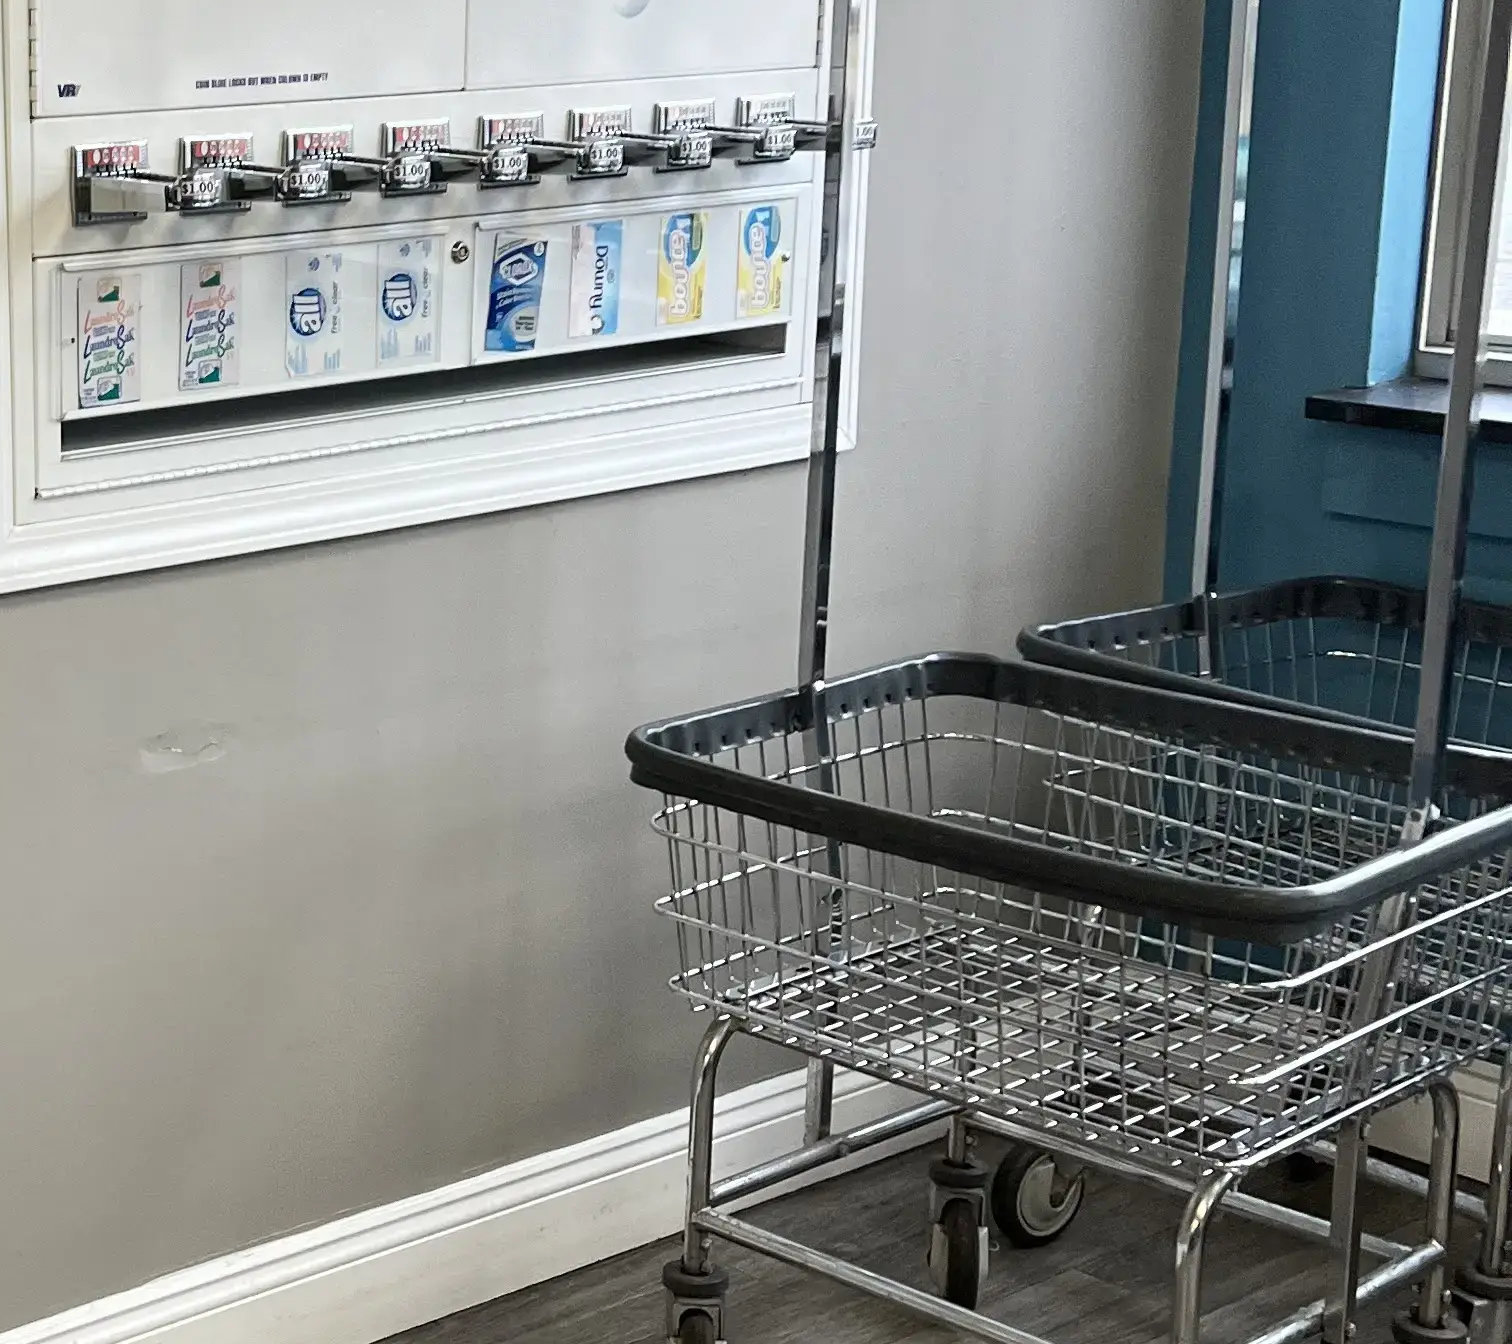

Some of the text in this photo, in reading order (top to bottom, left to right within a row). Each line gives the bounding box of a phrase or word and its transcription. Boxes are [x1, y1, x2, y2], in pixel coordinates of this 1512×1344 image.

[591, 147, 618, 159] $1.00
[682, 141, 708, 152] $1.00
[494, 156, 522, 168] $1.00
[394, 164, 424, 177] $1.00
[290, 173, 320, 186] $1.00
[182, 181, 214, 195] $1.00
[749, 222, 769, 308] bounce
[589, 245, 609, 310] Downy
[669, 230, 689, 317] bounce
[384, 279, 414, 318] all
[292, 294, 324, 333] all
